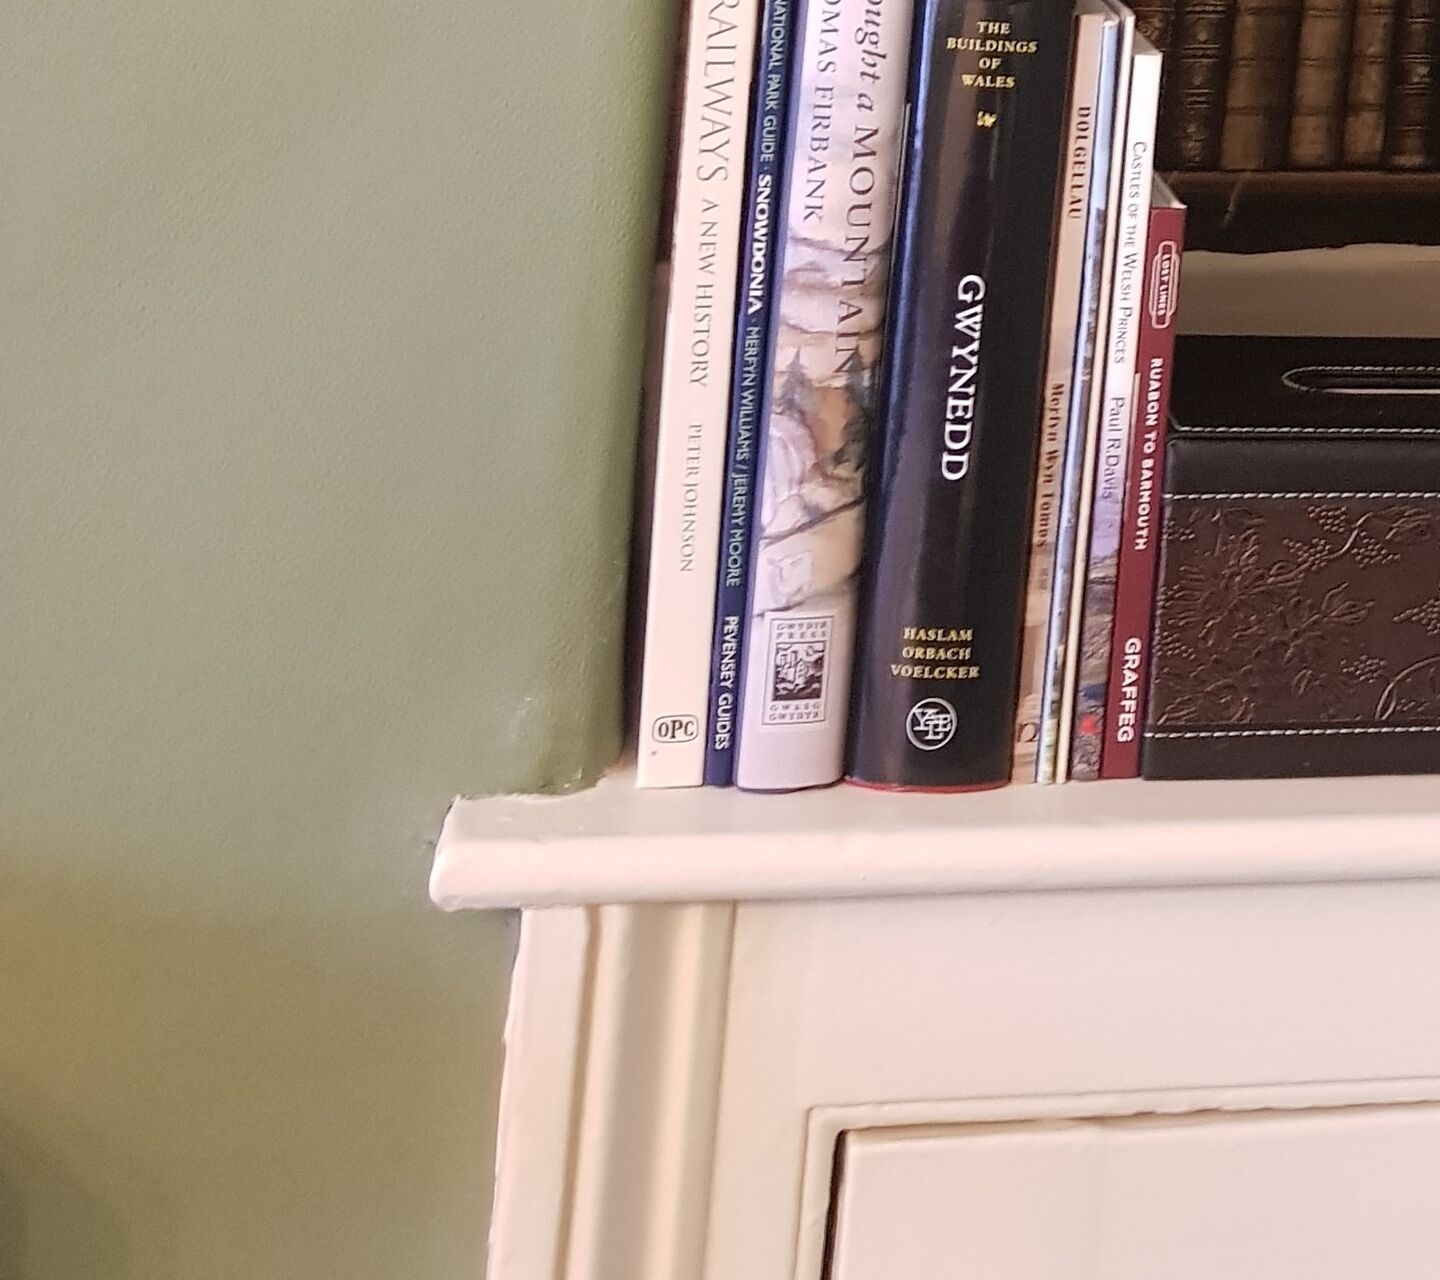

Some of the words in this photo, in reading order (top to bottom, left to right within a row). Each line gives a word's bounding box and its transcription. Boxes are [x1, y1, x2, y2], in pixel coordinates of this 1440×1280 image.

[946, 37, 1038, 53] BUILDINGS
[976, 21, 1010, 34] THE
[960, 75, 1016, 88] WALES
[978, 58, 1002, 69] OF
[764, 74, 782, 111] PARK
[856, 92, 876, 113] a
[760, 116, 780, 161] GUIDE
[802, 86, 834, 223] FIRBANK
[1068, 106, 1092, 220] DOLGELLAU
[702, 199, 720, 213] A
[696, 222, 716, 275] NEW
[746, 174, 772, 314] SNOWDONIA
[832, 126, 880, 378] MOUNTAIN
[1160, 254, 1170, 282] LOST
[1158, 284, 1168, 316] LINES
[688, 284, 714, 387] HISTORY
[742, 327, 760, 386] MERFYN
[940, 274, 986, 481] GWYNEDD
[1144, 358, 1164, 425] RUABON
[736, 390, 756, 460] WILLIAMS
[1046, 383, 1064, 442] Merfyn
[1106, 397, 1126, 432] Paul
[684, 424, 702, 478] PETER
[1040, 449, 1062, 484] Wyn
[1142, 430, 1156, 453] TO
[730, 471, 748, 525] JEREMY
[1134, 459, 1154, 551] BARMOUTH
[680, 481, 698, 573] JOHNSON
[724, 529, 742, 587] MOORE
[718, 616, 738, 687] PEVENSEY
[902, 627, 972, 641] HASLAM
[902, 646, 972, 660] ORBACH
[890, 664, 980, 679] VOELCKER
[1116, 637, 1142, 742] GRAFFEG
[658, 720, 694, 738] OPC
[712, 693, 732, 750] GUIDES
